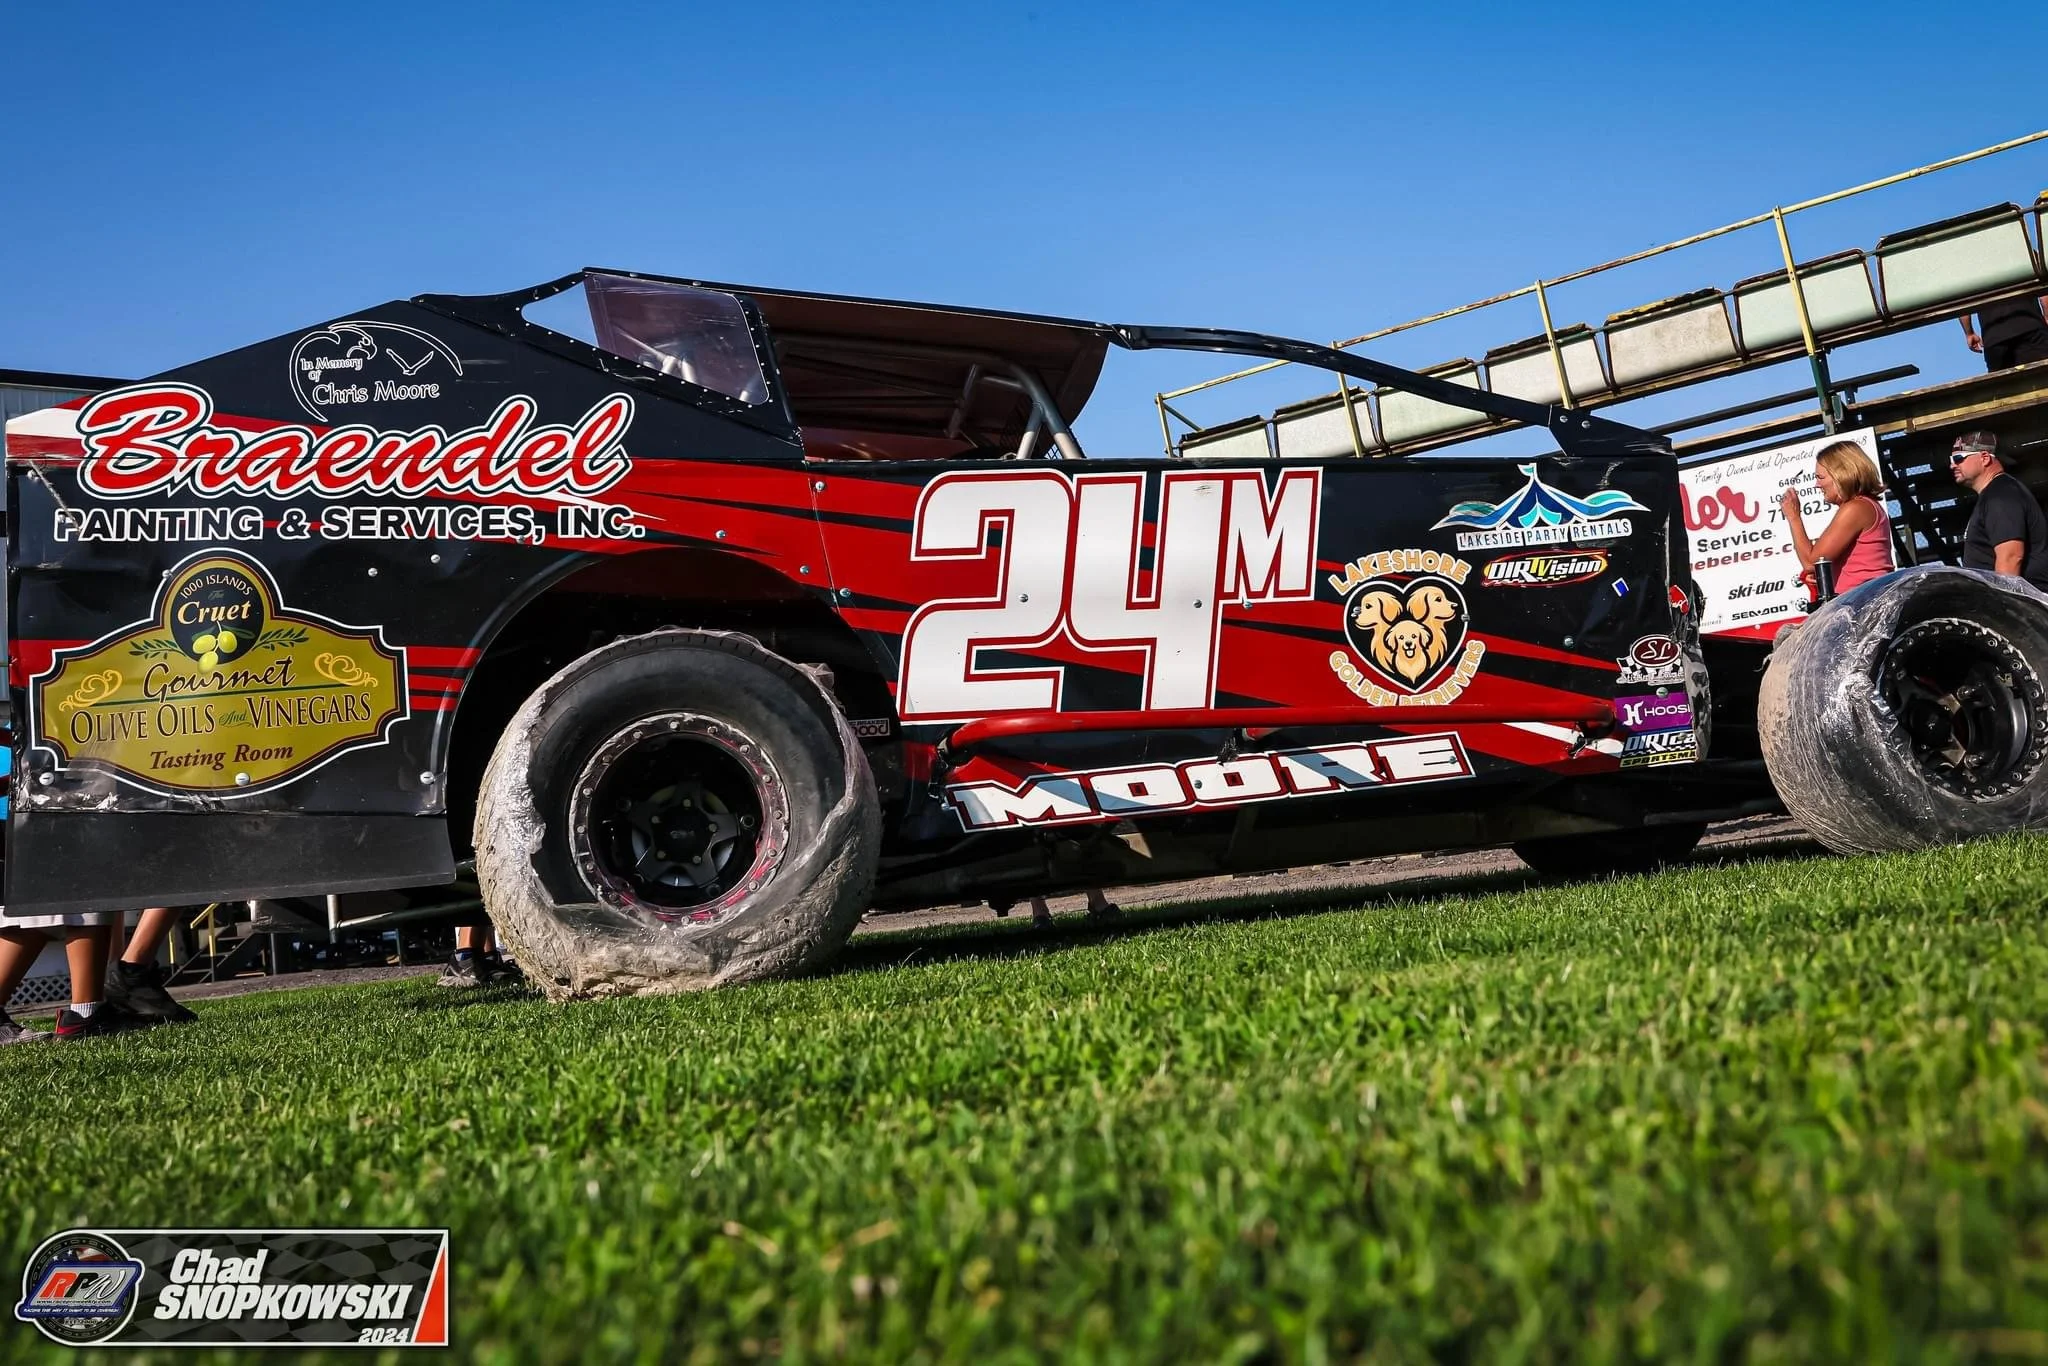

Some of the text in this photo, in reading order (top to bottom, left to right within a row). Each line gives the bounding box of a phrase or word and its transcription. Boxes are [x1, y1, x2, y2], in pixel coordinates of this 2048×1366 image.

[300, 356, 363, 371] In Memory
[312, 380, 441, 405] Chris Moore
[77, 382, 635, 500] Braendel
[1726, 459, 1754, 477] Owned
[1774, 446, 1815, 470] Operated
[54, 504, 645, 543] PAINTING & SERVICES, INC.
[1459, 521, 1631, 548] LAKESIDE PARTY RENTALS
[1697, 529, 1773, 553] Service
[180, 574, 253, 599] 1000 ISLANDS
[1328, 548, 1472, 596] LAKESHORE
[177, 600, 251, 625] Cruet
[143, 655, 297, 703] Gourmet
[1329, 650, 1399, 706] GOLDEN
[149, 743, 294, 771] Tasting Room
[945, 731, 1476, 833] MOORE
